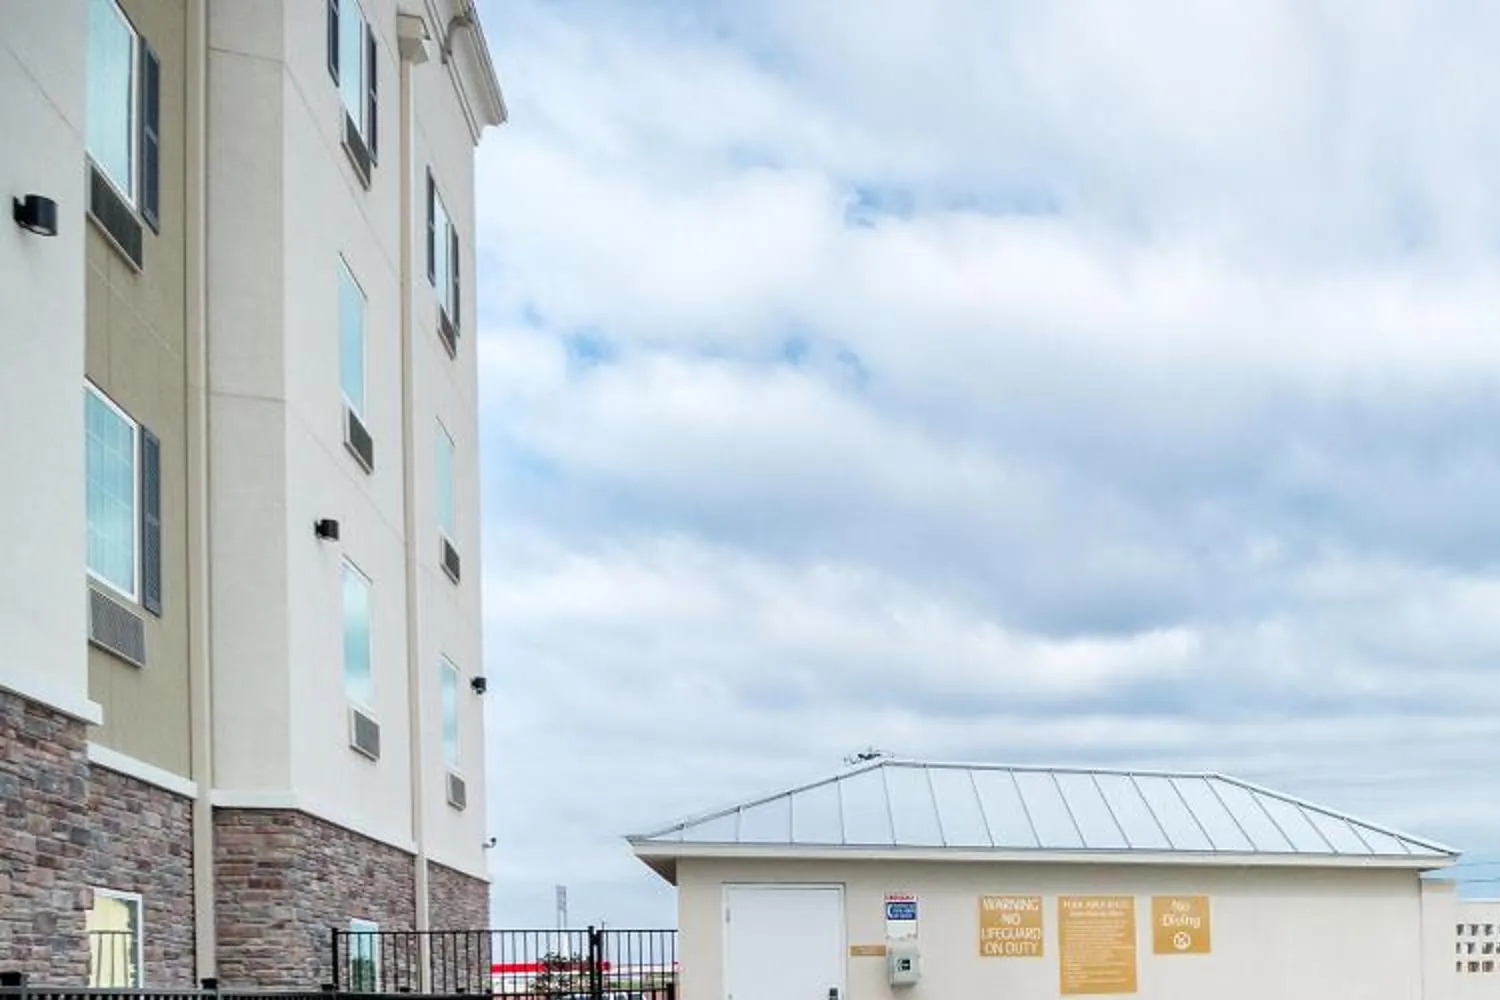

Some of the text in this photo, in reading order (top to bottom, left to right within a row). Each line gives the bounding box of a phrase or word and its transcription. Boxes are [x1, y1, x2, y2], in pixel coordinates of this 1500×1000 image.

[983, 898, 1039, 911] WARNING
[1001, 912, 1021, 926] NO
[1161, 913, 1201, 929] Diving
[981, 927, 1041, 940] LIFEGUARD
[985, 941, 1037, 954] ON DUTY
